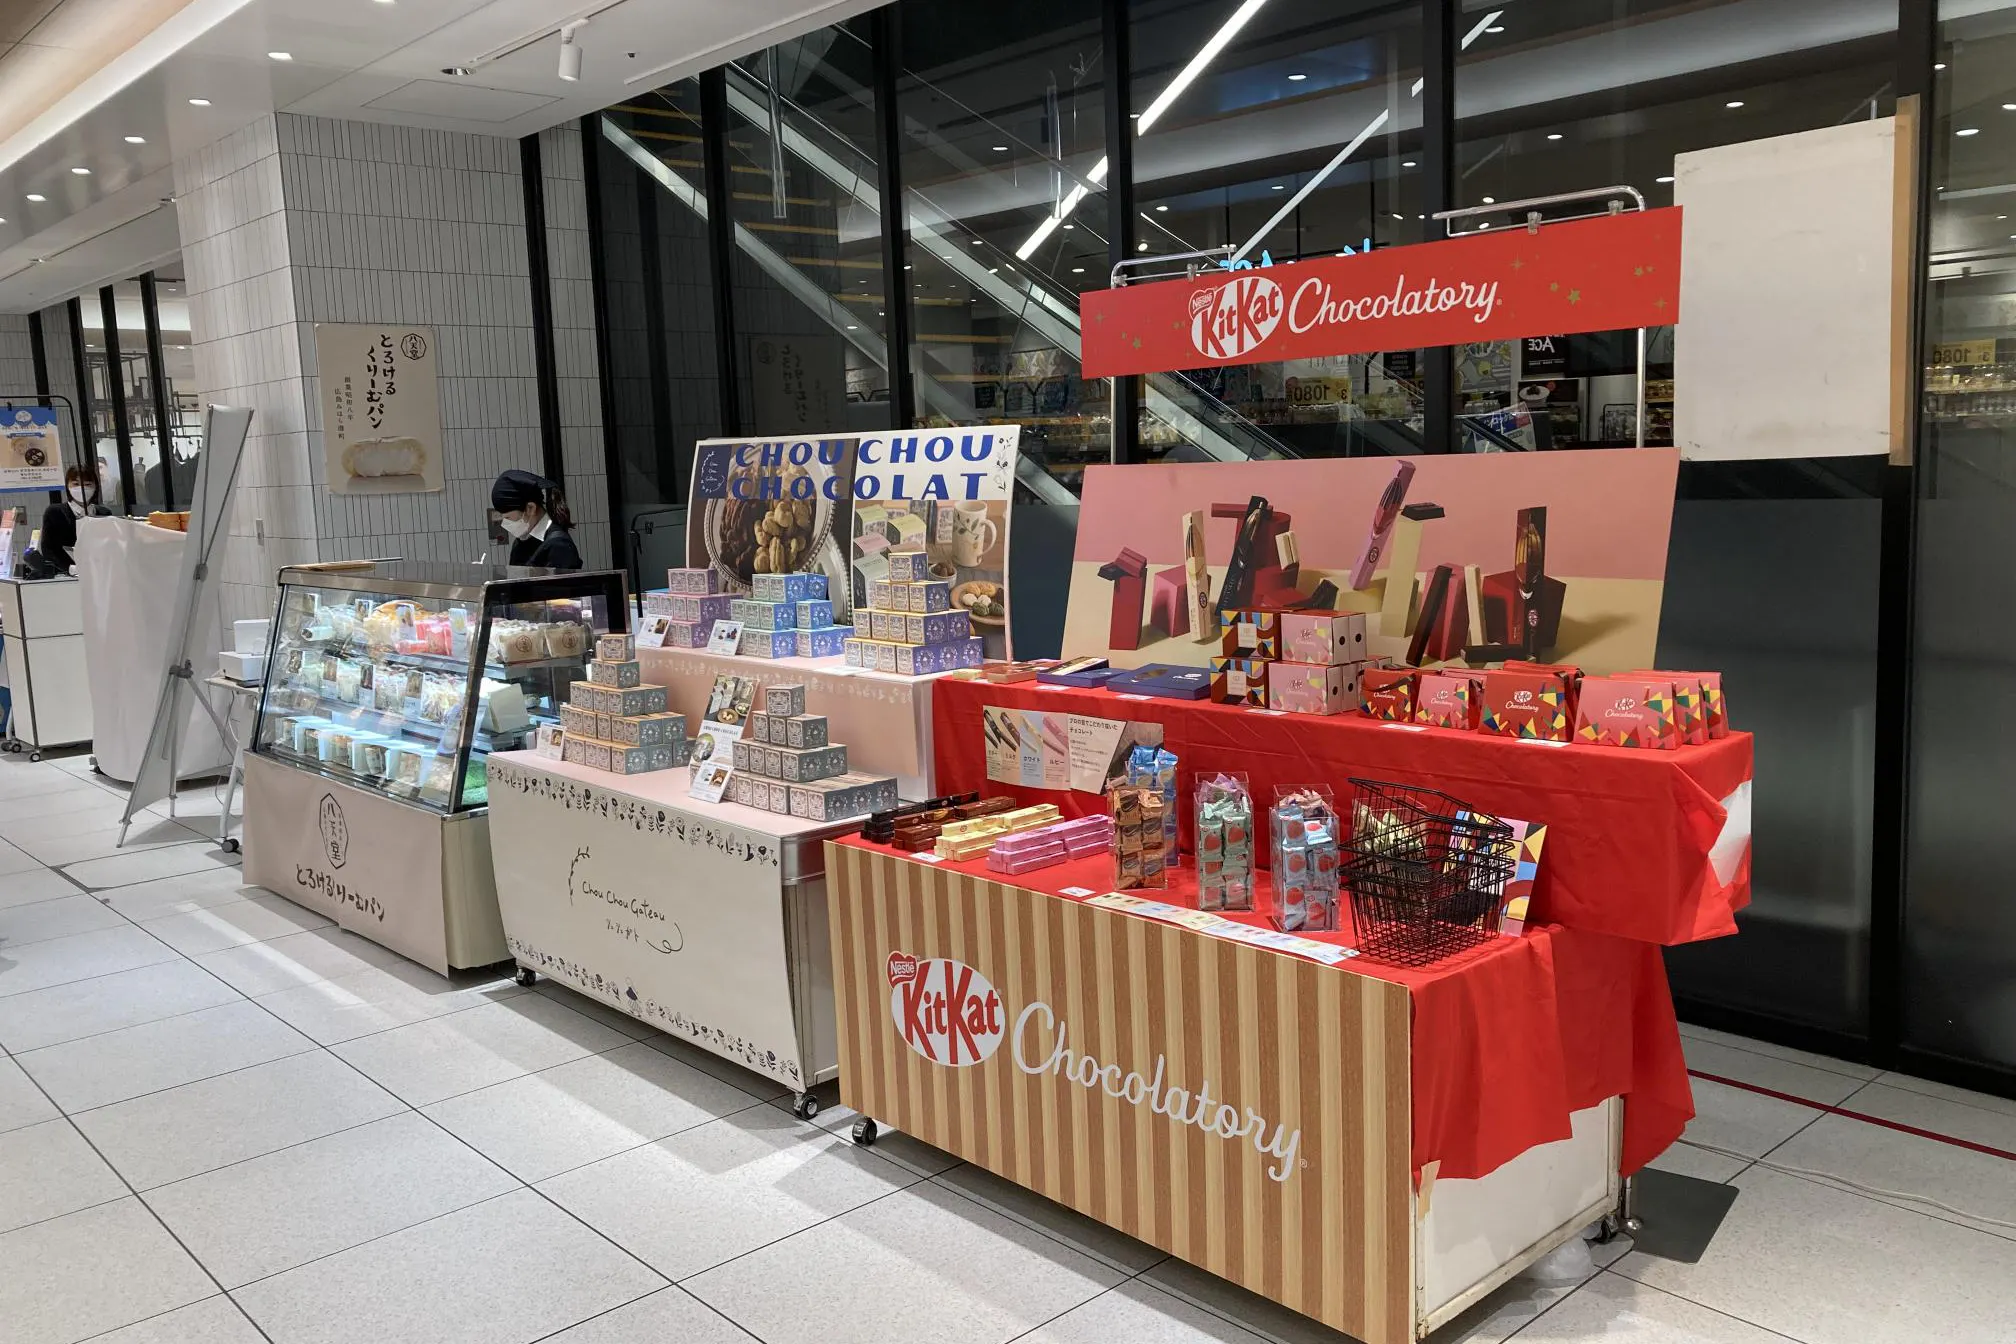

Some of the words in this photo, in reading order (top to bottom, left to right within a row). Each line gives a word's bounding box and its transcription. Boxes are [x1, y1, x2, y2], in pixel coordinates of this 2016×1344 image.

[1200, 277, 1280, 358] KitKat
[1288, 274, 1498, 335] Chocolatory
[366, 345, 385, 429] くりーむパン
[380, 334, 396, 395] とろける
[735, 440, 846, 467] CHOU
[858, 434, 994, 464] CHOU
[731, 472, 988, 501] CHOCOLAT
[582, 881, 604, 899] Chou
[606, 890, 629, 909] Chou
[630, 898, 665, 922] Gateau
[903, 959, 1001, 1065] KitKat
[1012, 1001, 1300, 1182] Chocolatory
